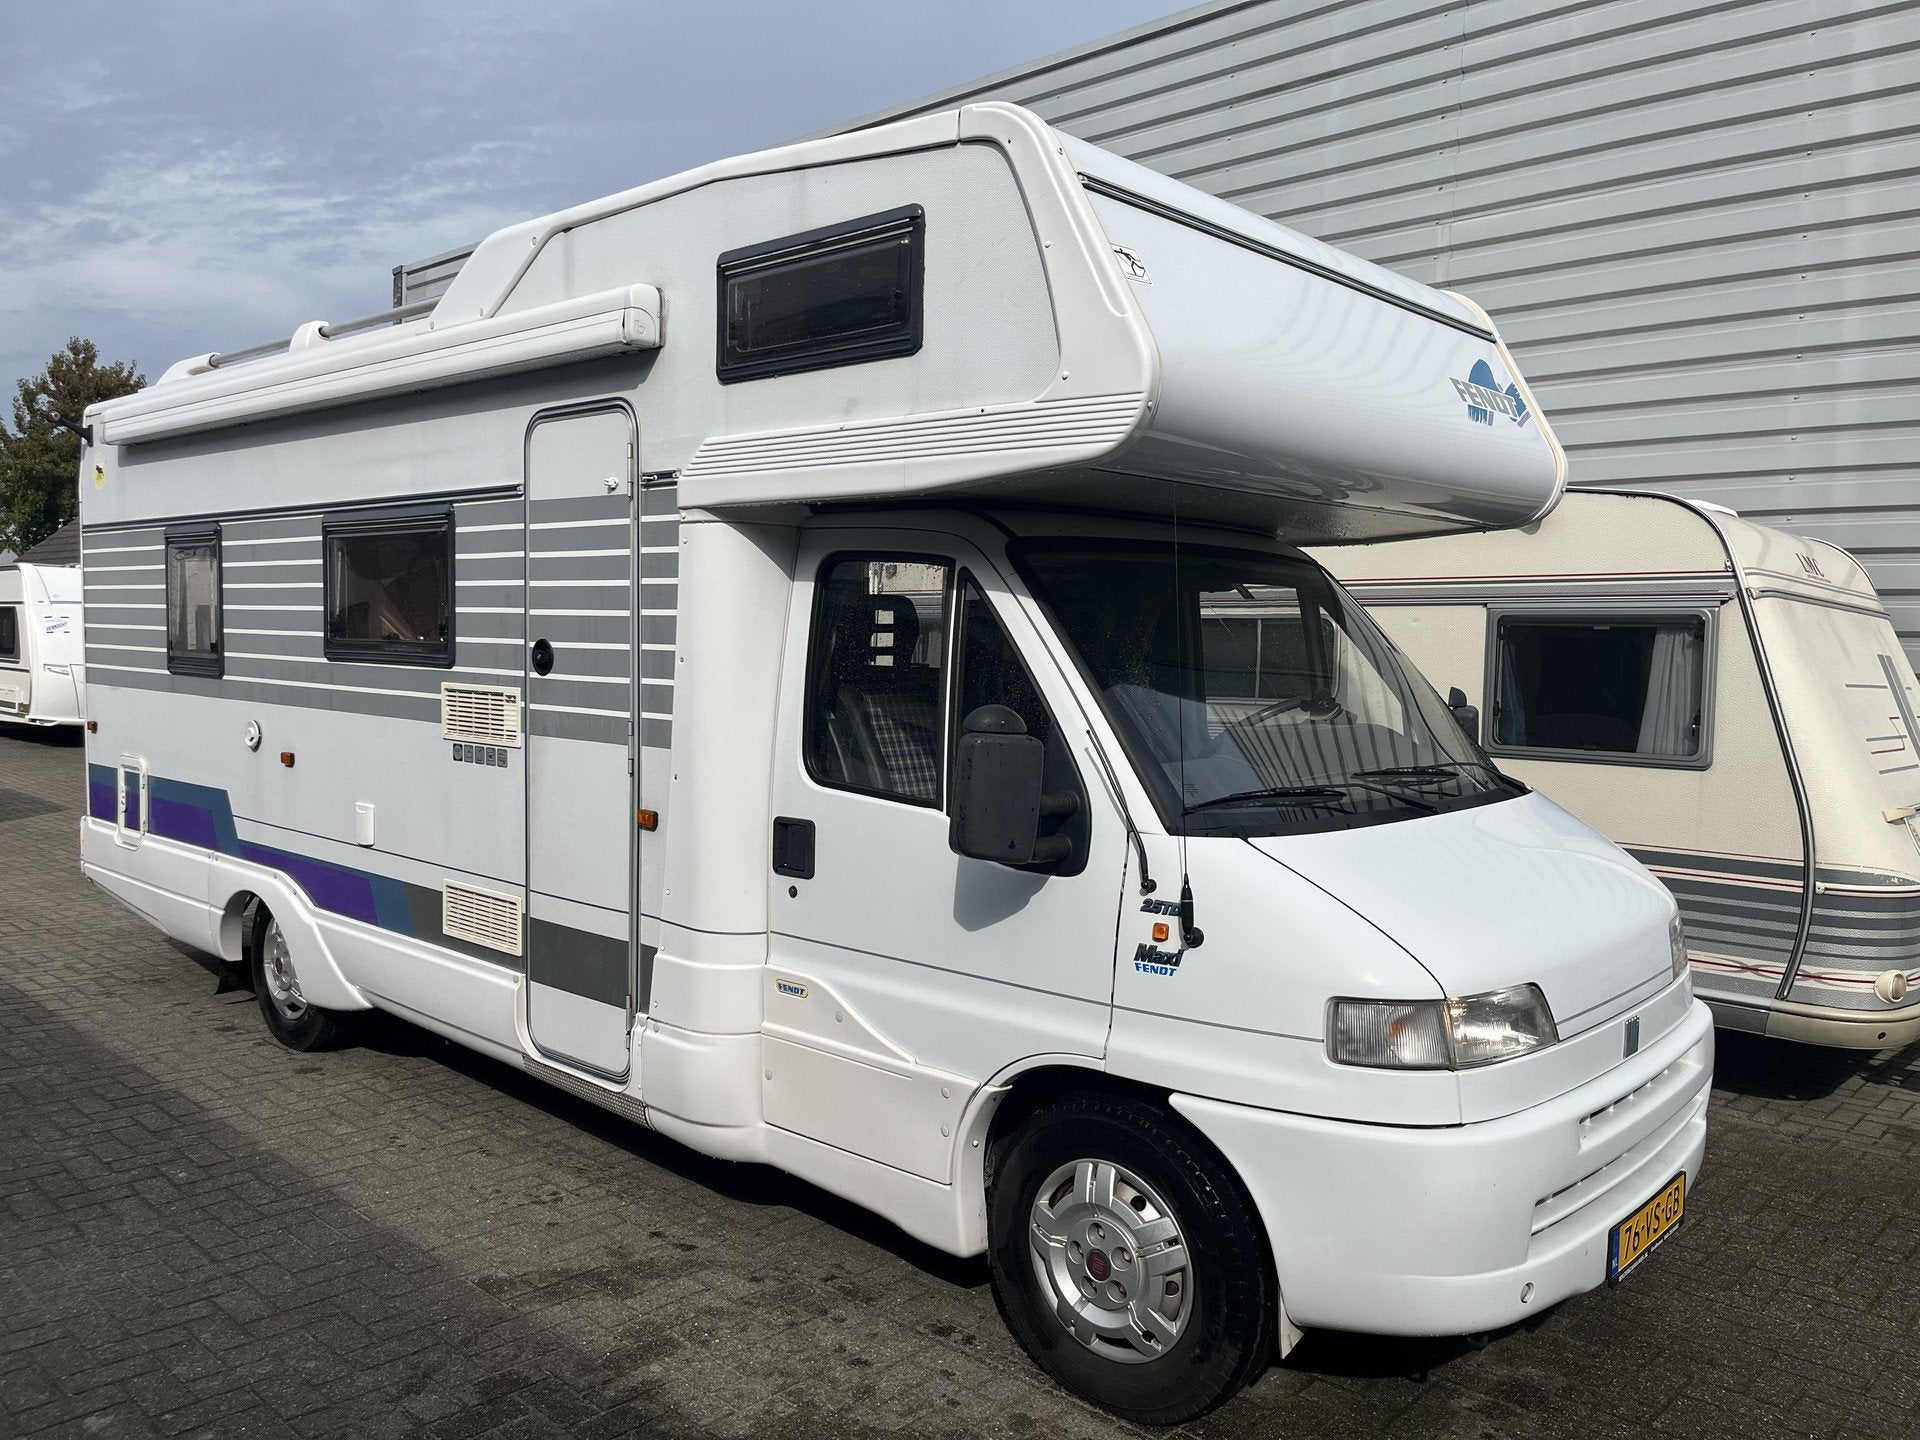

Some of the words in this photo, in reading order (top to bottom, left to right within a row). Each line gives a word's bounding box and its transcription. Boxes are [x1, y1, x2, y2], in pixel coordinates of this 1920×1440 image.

[1449, 377, 1518, 418] FENDT
[1795, 552, 1825, 578] LMC
[1140, 898, 1182, 917] 25TD
[1133, 943, 1185, 967] Maxi
[1134, 963, 1178, 976] FENDT
[777, 982, 805, 995] FENDT
[1624, 1185, 1680, 1261] 76-VS-GB
